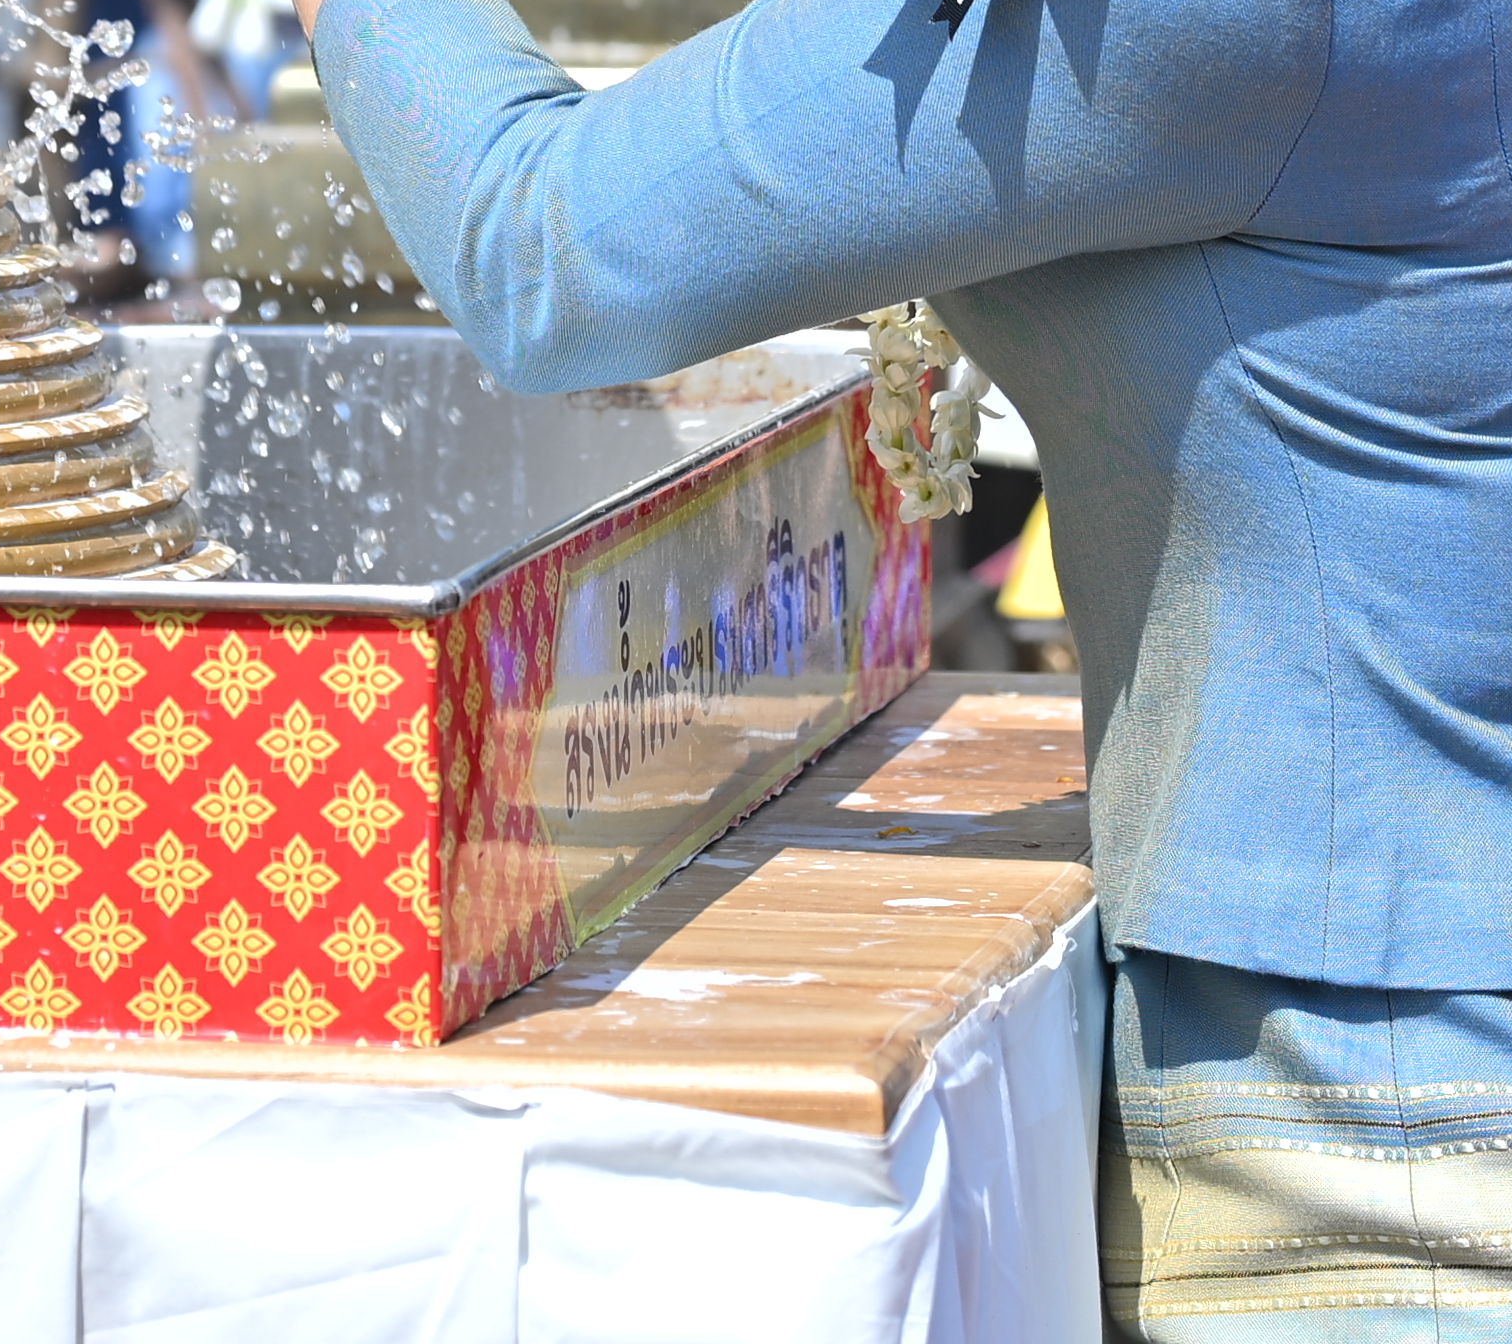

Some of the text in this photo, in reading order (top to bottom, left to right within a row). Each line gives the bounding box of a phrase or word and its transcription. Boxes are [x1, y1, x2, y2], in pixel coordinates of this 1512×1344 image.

[564, 515, 847, 820] สรงน้ำพระบรมสารีริกธาตุ
